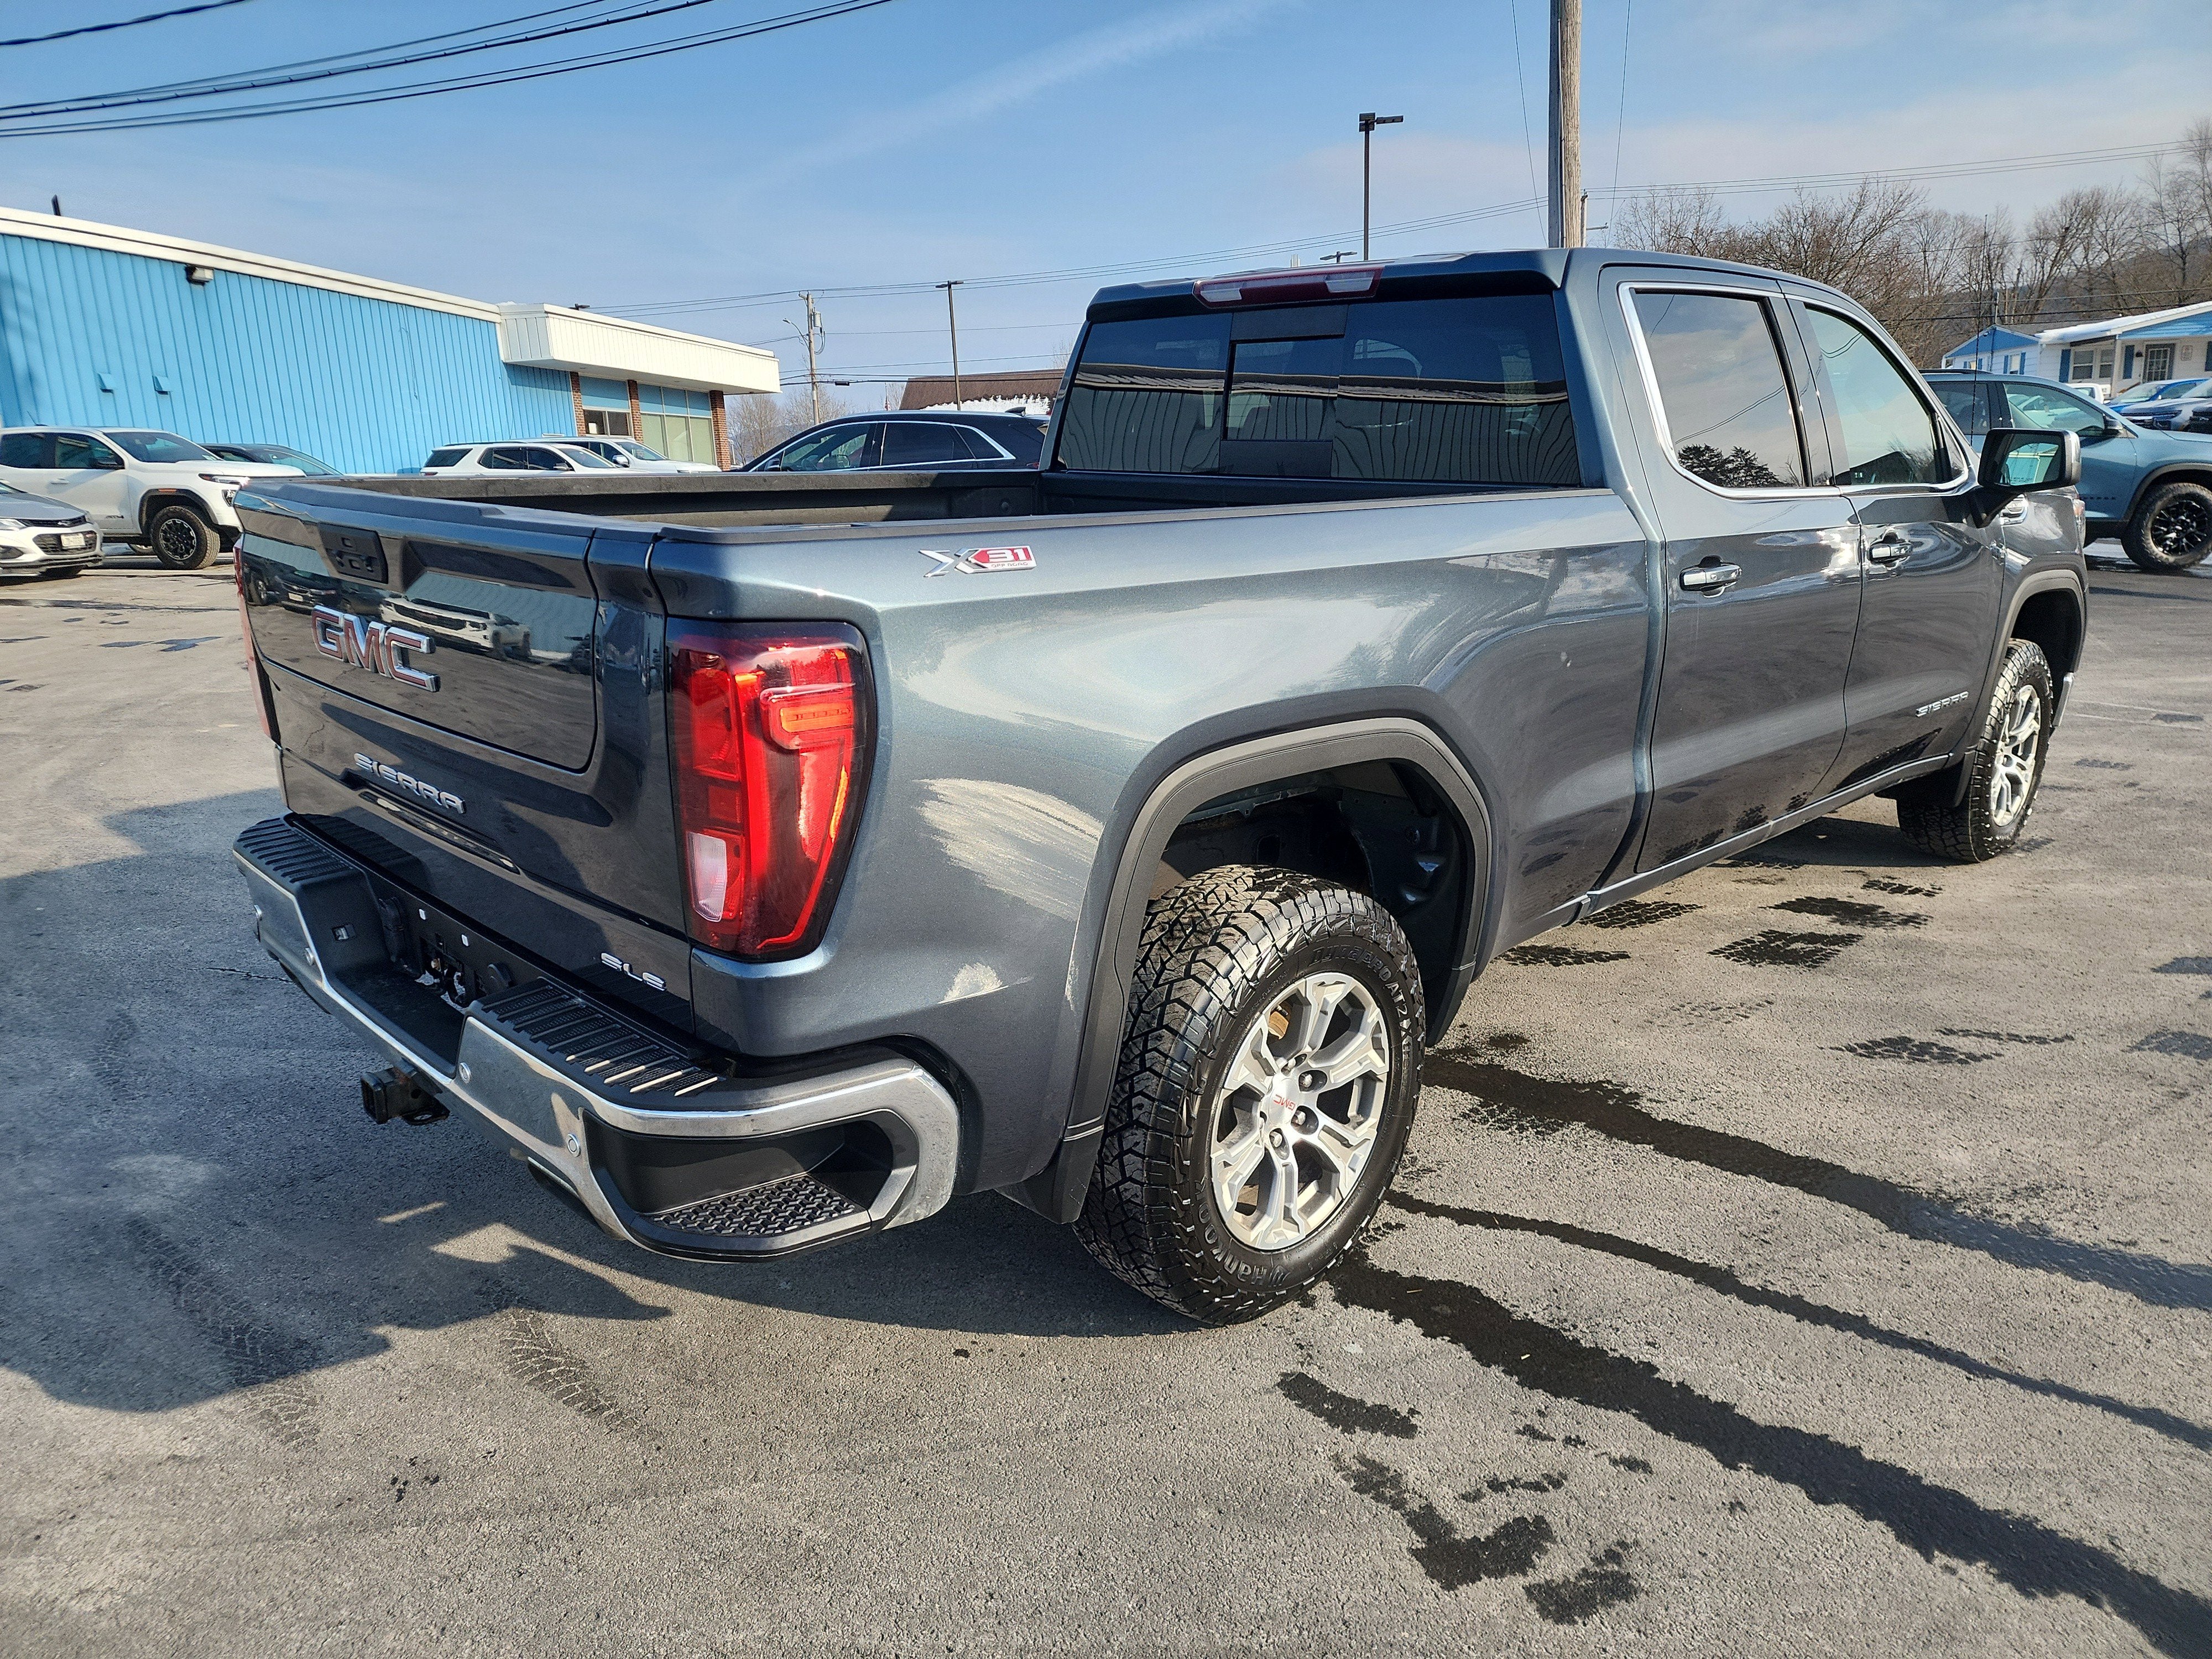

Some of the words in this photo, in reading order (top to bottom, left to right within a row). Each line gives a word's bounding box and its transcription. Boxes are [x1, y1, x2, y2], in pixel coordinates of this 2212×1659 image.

[918, 545, 1035, 577] X31
[311, 604, 441, 692] GMC
[1916, 691, 1969, 717] SIERRA
[353, 752, 467, 815] SIERRA
[601, 952, 667, 992] SLE
[1273, 1094, 1296, 1111] GMC
[1194, 1175, 1268, 1286] Hankook
